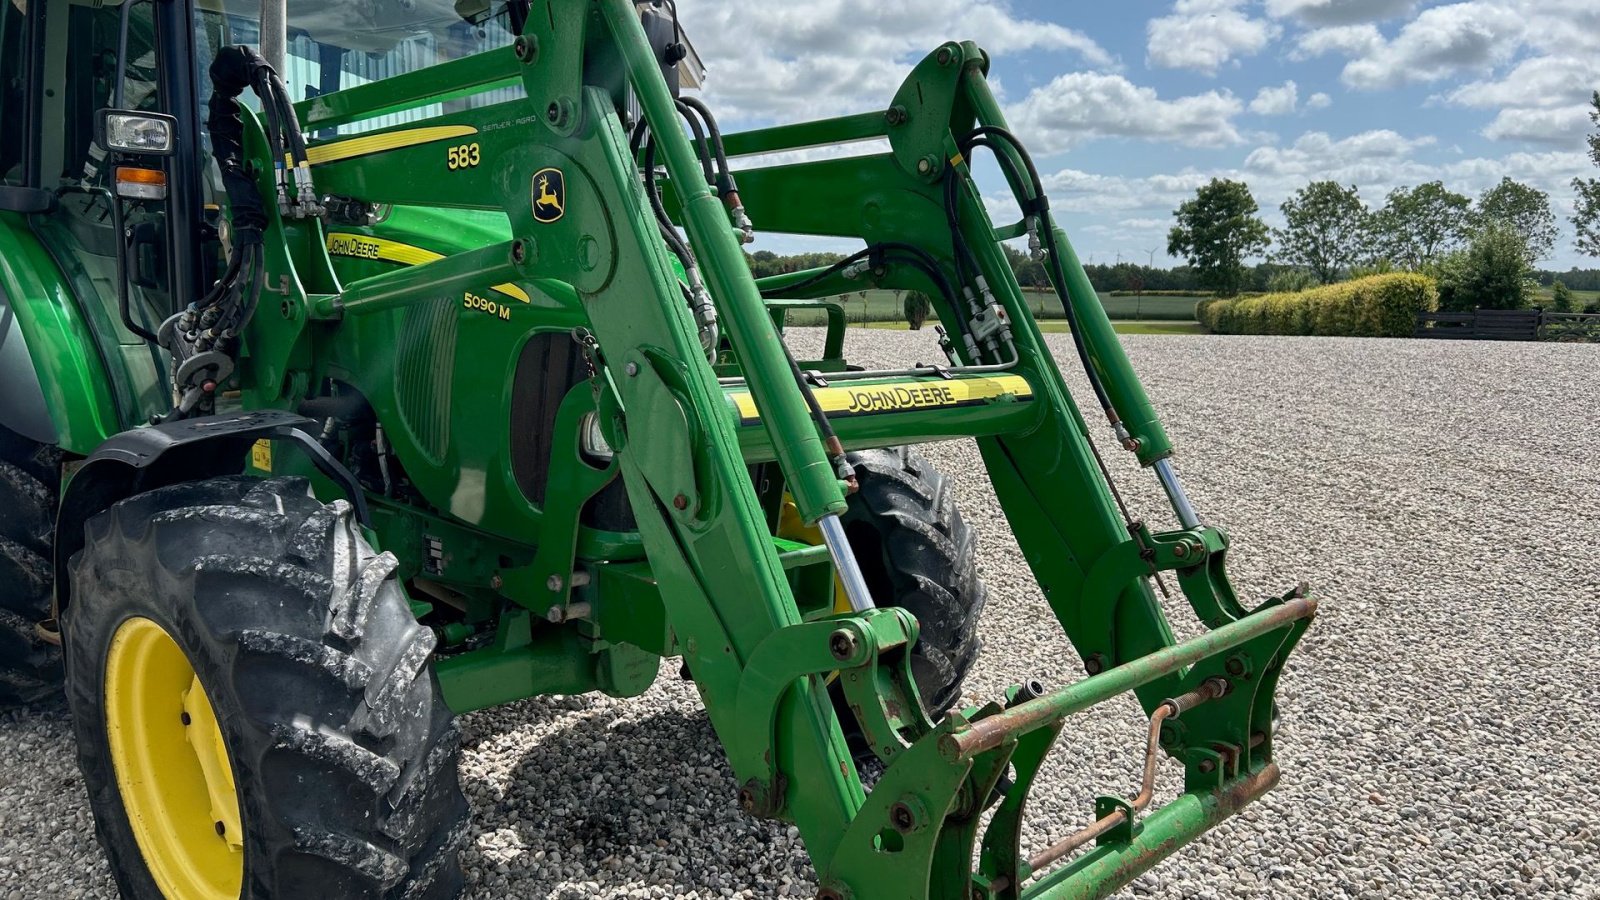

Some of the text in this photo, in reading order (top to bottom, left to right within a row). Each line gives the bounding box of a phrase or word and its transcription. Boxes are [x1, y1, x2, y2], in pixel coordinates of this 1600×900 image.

[448, 142, 480, 169] 583
[350, 238, 379, 257] DEERE
[464, 292, 510, 320] 5090 M
[848, 387, 954, 410] JOHN DEERE
